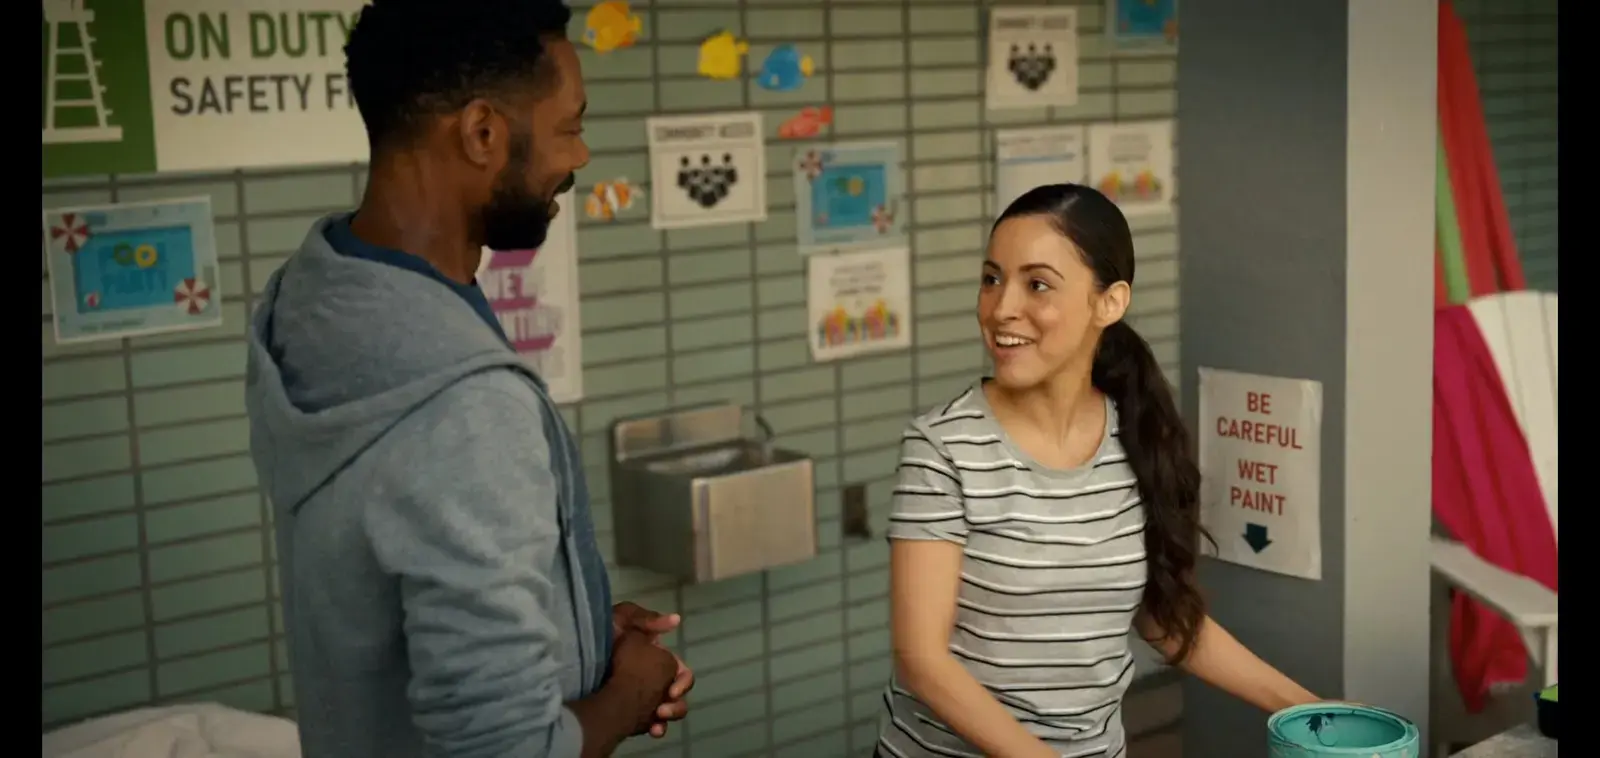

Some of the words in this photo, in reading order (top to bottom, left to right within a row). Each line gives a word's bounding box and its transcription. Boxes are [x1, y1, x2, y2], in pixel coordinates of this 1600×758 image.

[163, 11, 231, 61] ON
[250, 10, 358, 59] DUTY
[170, 73, 312, 116] SAFETY
[1246, 391, 1272, 415] BE
[1216, 416, 1303, 450] CAREFUL
[1237, 458, 1279, 485] WET
[1229, 486, 1287, 516] PAINT
